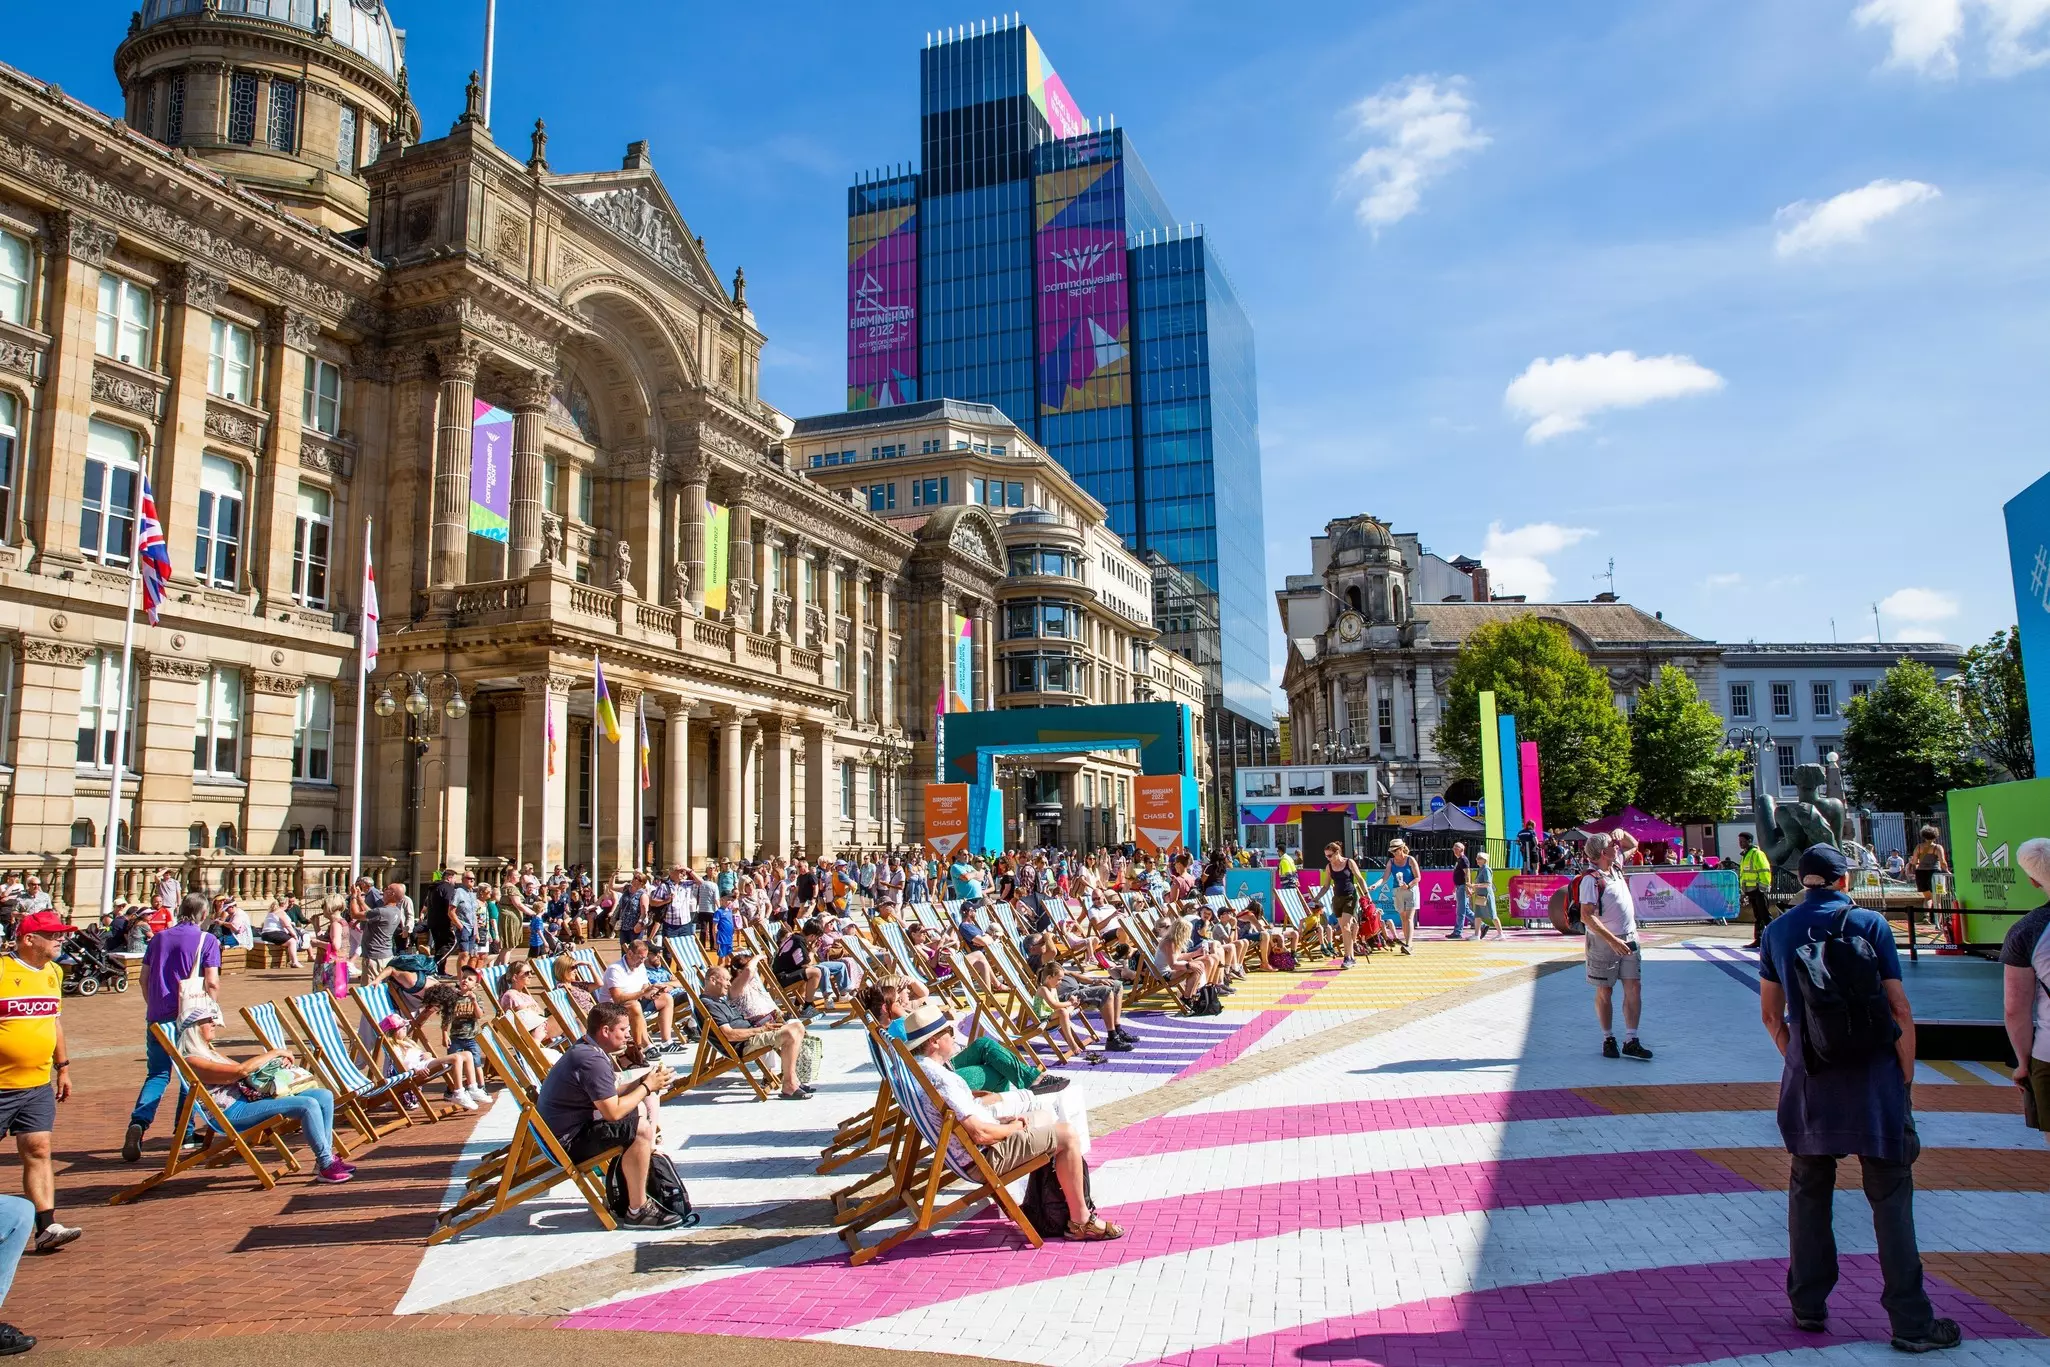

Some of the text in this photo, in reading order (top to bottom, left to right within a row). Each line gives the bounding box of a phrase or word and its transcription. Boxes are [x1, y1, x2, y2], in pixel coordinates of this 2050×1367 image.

[1044, 272, 1122, 293] commonwealth
[1069, 285, 1096, 297] sport
[850, 308, 914, 329] BIRMINGHAM
[869, 323, 895, 337] 2022
[1142, 788, 1173, 796] BIRMINGHAM
[1970, 868, 2016, 884] BIRMINGHAM 2022
[1983, 884, 2006, 900] FESTIVAL
